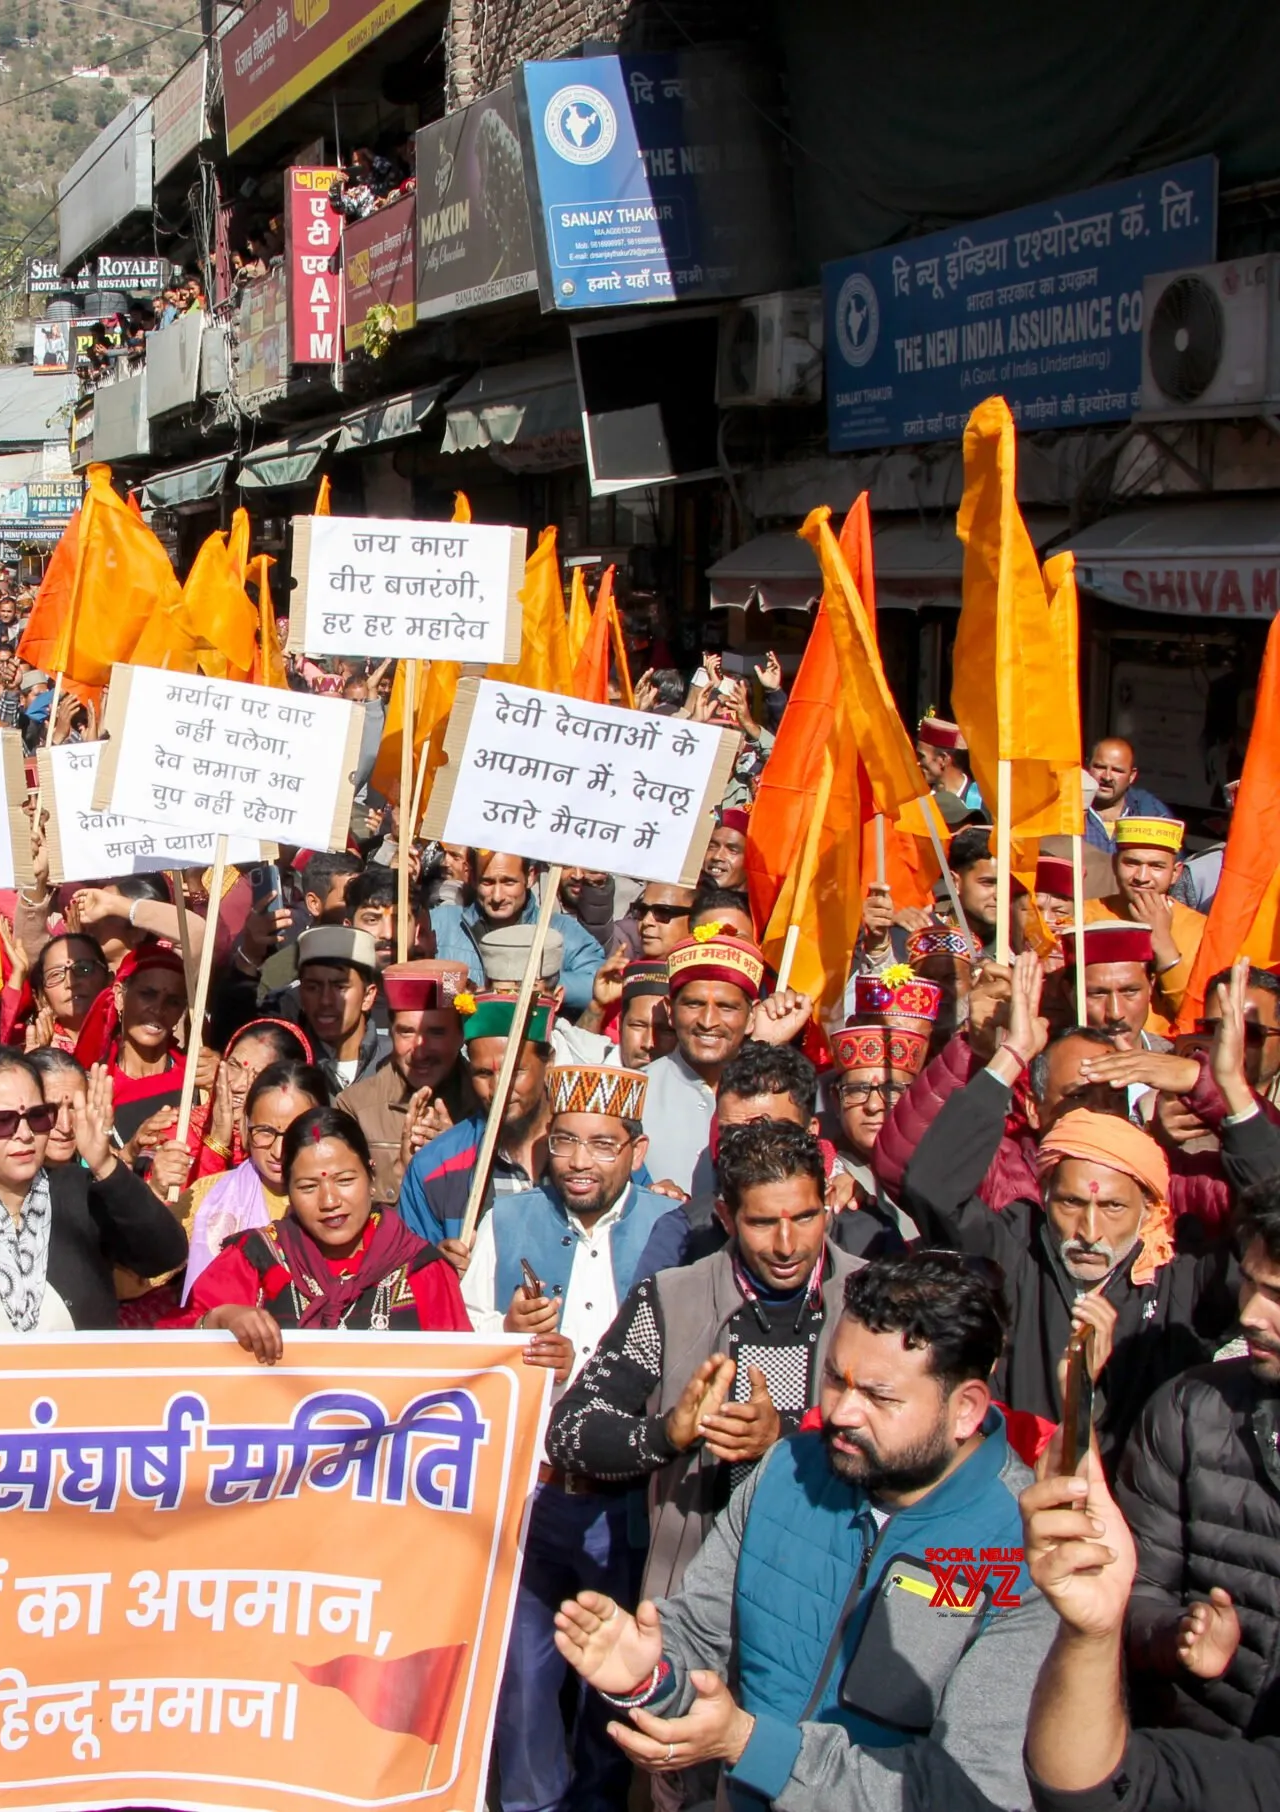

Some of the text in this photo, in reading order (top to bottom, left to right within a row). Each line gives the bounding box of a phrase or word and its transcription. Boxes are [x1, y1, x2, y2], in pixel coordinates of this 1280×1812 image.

[347, 5, 397, 53] BRANCH DHALPUR
[637, 147, 676, 178] THE
[420, 198, 471, 248] MAXUM
[561, 206, 674, 228] SANJAY THAKUR
[892, 255, 910, 297] दि
[915, 258, 945, 300] न्यू
[1160, 180, 1200, 233] लि.
[31, 278, 158, 292] HOTEL RESTAURANT
[98, 256, 159, 277] ROYALE
[586, 270, 622, 293] हमारे
[624, 268, 651, 289] यहाँ
[653, 271, 672, 286] पर
[455, 275, 529, 306] RANA CONFECTIONERY
[966, 267, 1099, 312] भारत सरकार का उपक्रम
[893, 333, 923, 374] THE
[926, 326, 959, 369] NEW
[962, 318, 1004, 362] INDIA
[1008, 296, 1112, 353] ASSURANCE
[973, 364, 997, 385] Govt.
[1001, 360, 1011, 381] of
[1013, 357, 1038, 379] India
[1041, 346, 1112, 375] Undertaking)
[29, 484, 62, 497] MOBILE
[4, 531, 28, 539] MINUTE
[29, 531, 60, 539] PASSPORT
[352, 533, 469, 558] जय कारा
[329, 565, 485, 604] वीर बजरंगी,
[322, 612, 490, 641] हर हर महादेव
[166, 683, 316, 729] मर्यादा पर वार
[495, 693, 700, 757] देवी देवताओं के
[175, 718, 292, 760] नहीं चलेगा,
[65, 751, 96, 771] देव
[154, 744, 304, 793] देव समाज अब
[473, 747, 695, 817] अपमान में, देवलू
[76, 810, 127, 831] देवता
[150, 783, 297, 826] चुप नहीं रहेगा
[481, 799, 661, 851] उतरे मैदान में
[104, 831, 216, 859] सबसे प्यारा
[669, 949, 698, 967] देवता
[701, 948, 742, 965] महर्षि
[206, 1387, 490, 1514] समिति
[14, 1571, 112, 1639] का
[124, 1568, 394, 1656] अपमान,
[109, 1676, 299, 1740] समाज।
